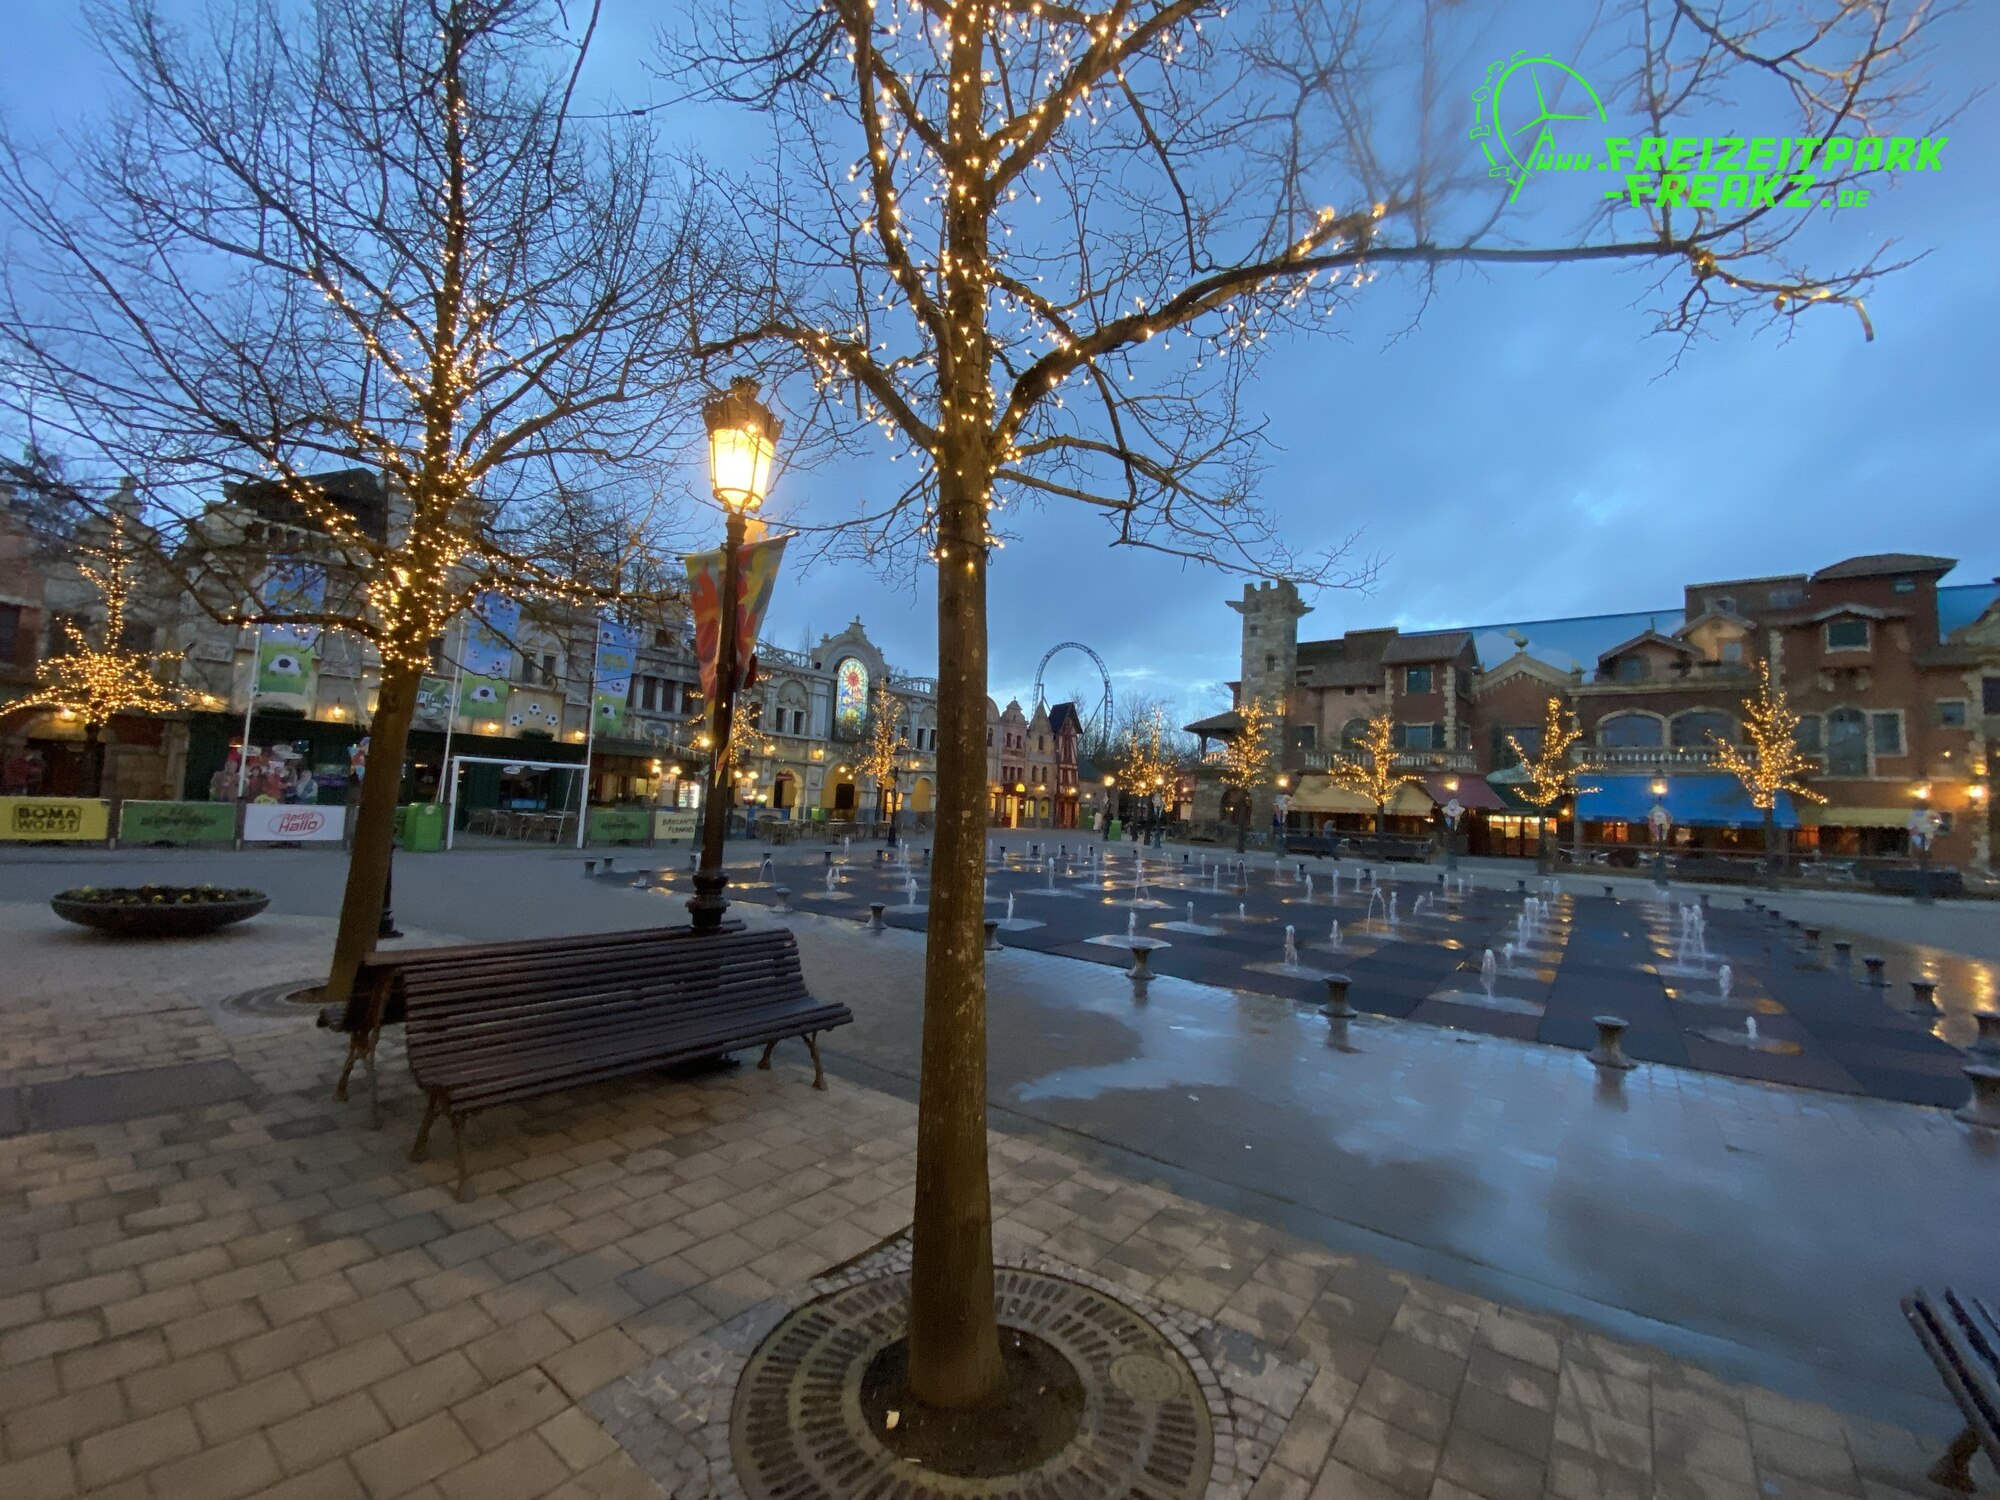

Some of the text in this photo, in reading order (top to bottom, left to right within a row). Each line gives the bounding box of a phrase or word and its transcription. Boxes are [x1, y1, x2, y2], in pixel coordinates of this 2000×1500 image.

[19, 807, 77, 819] BOMA
[18, 820, 75, 831] WORST
[278, 821, 318, 832] Hallo
